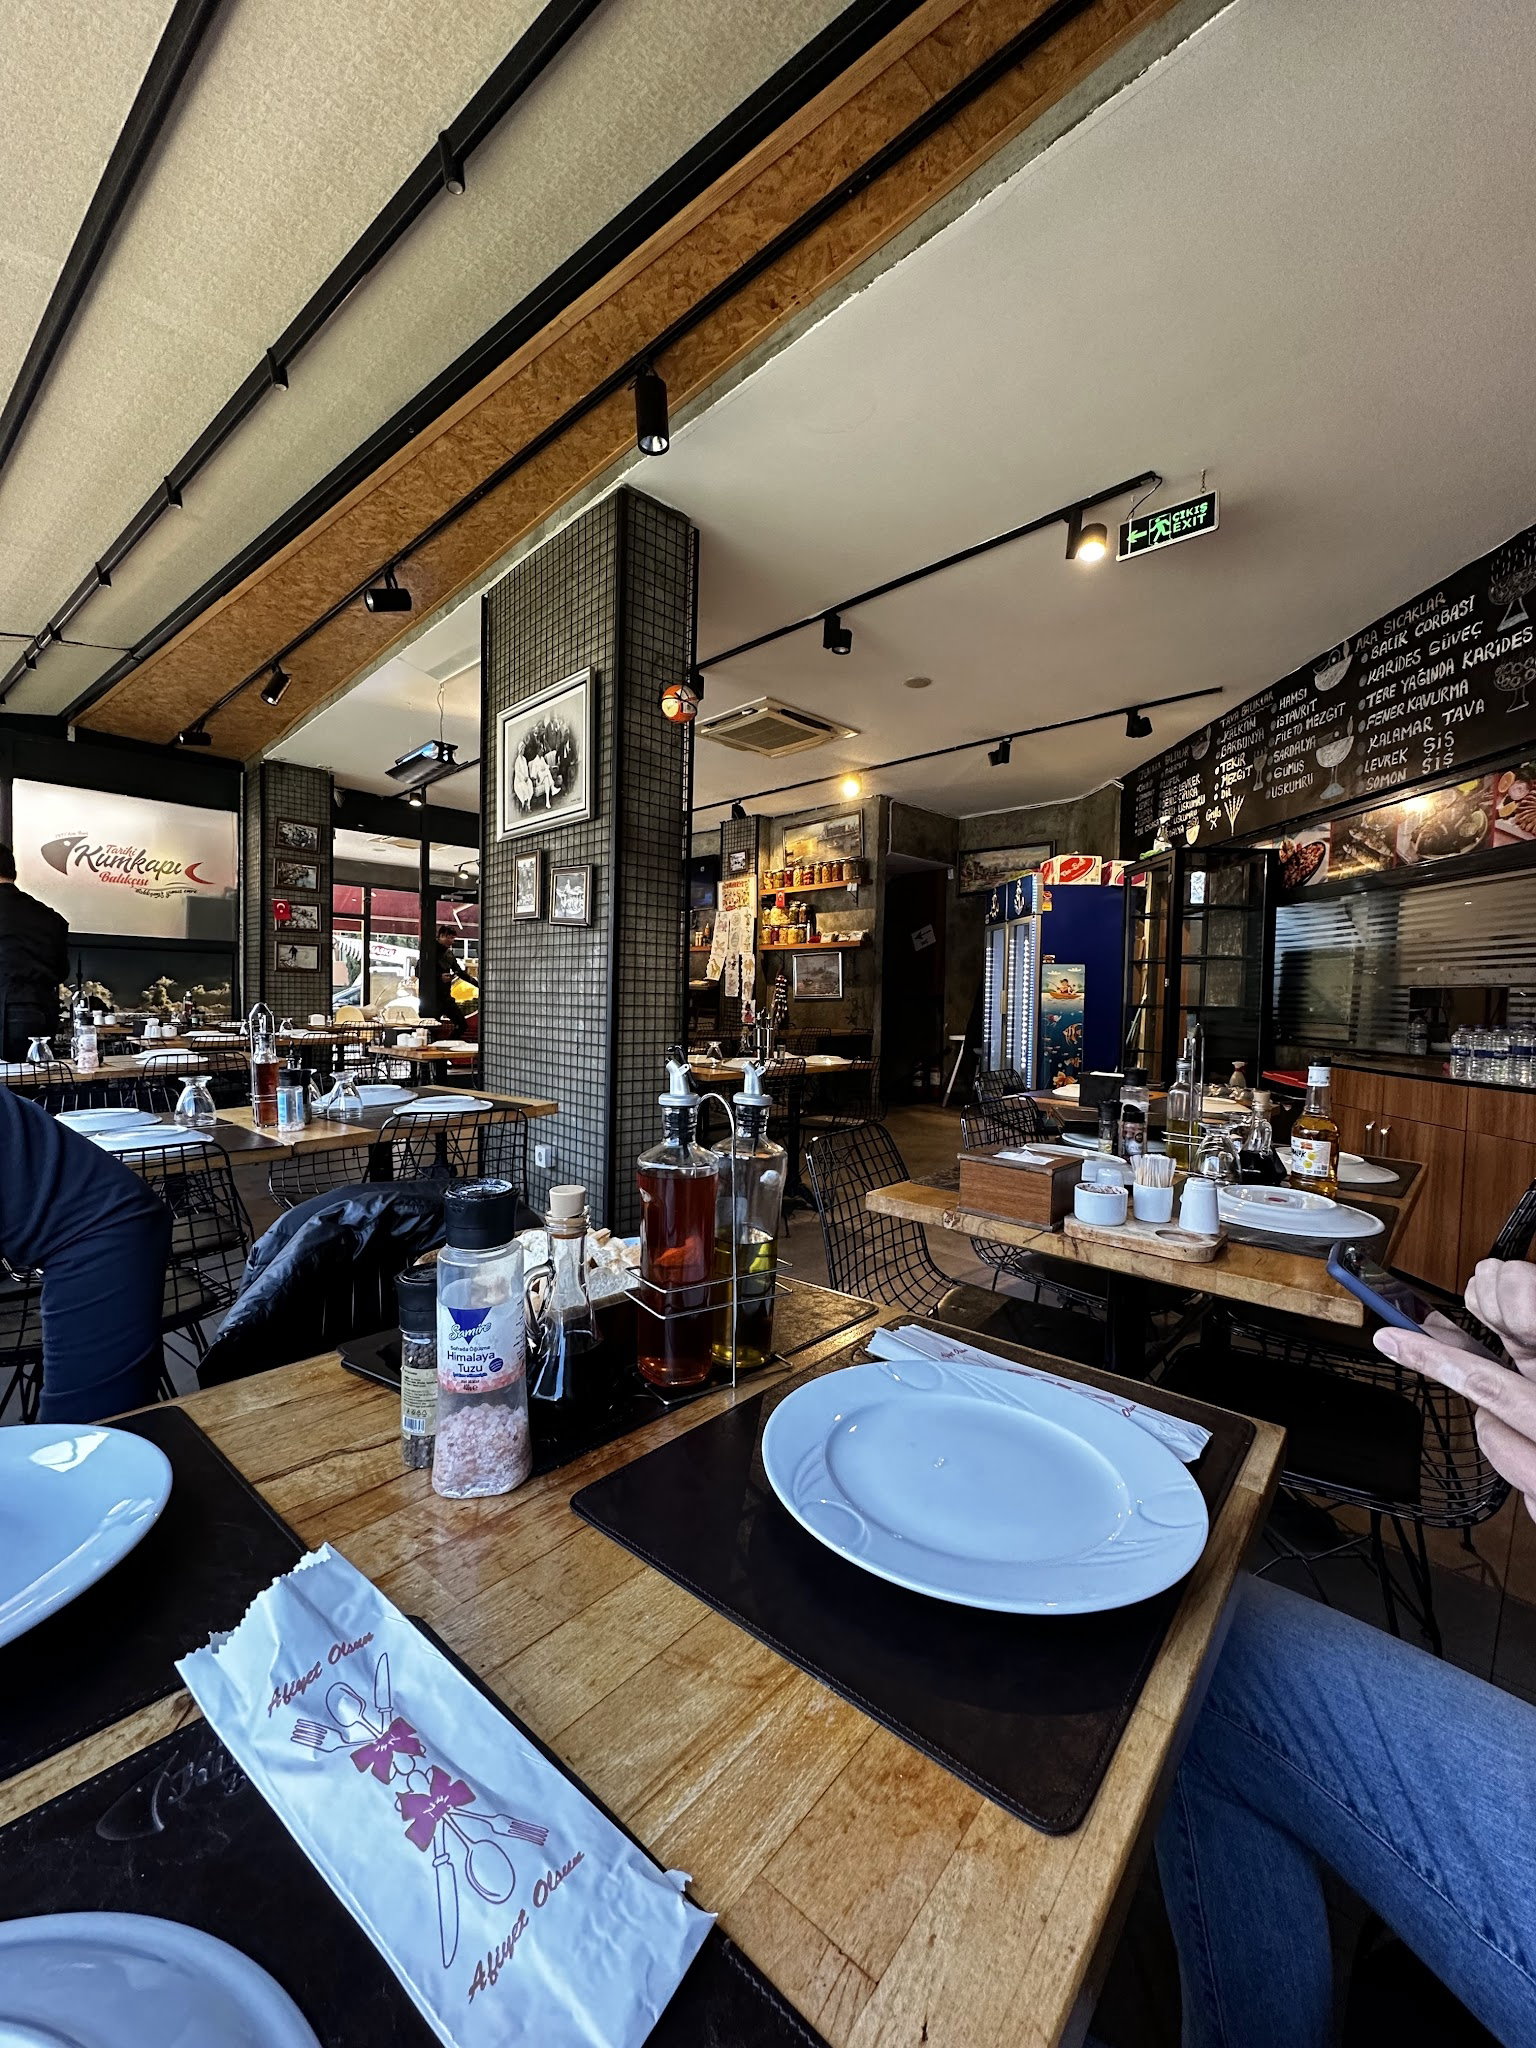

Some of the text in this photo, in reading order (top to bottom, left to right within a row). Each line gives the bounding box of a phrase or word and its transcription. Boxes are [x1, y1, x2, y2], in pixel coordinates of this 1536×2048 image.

[1172, 513, 1207, 533] EXIT
[1355, 591, 1446, 652] ARA SICAKLAR
[1367, 621, 1483, 685] KARİDES GÜVEÇ
[1370, 630, 1408, 659] BALIK
[1365, 626, 1533, 709] TERE YAĞINDA KARİDES
[1305, 702, 1347, 730] MEZGİT
[1365, 678, 1469, 730] FENER KAVURMA
[1367, 698, 1485, 753] KALAMAR TAVA
[1219, 727, 1265, 760] BARBUNYA
[1273, 735, 1316, 763] SARDALYA
[1364, 731, 1455, 773] LEVREK ŞİŞ
[1220, 751, 1246, 774] TEKİR
[1271, 773, 1314, 798] USKUMRU
[1365, 768, 1408, 791] SOMON
[74, 844, 182, 880] Kumkapı
[106, 844, 138, 857] Tarihi
[99, 871, 149, 888] Balıkçısı
[447, 1350, 495, 1363] Himalaya
[458, 1363, 483, 1373] Tuzu
[267, 1631, 374, 1718] Afiyet Olsun
[468, 1851, 585, 2005] Afiyet Olsun
